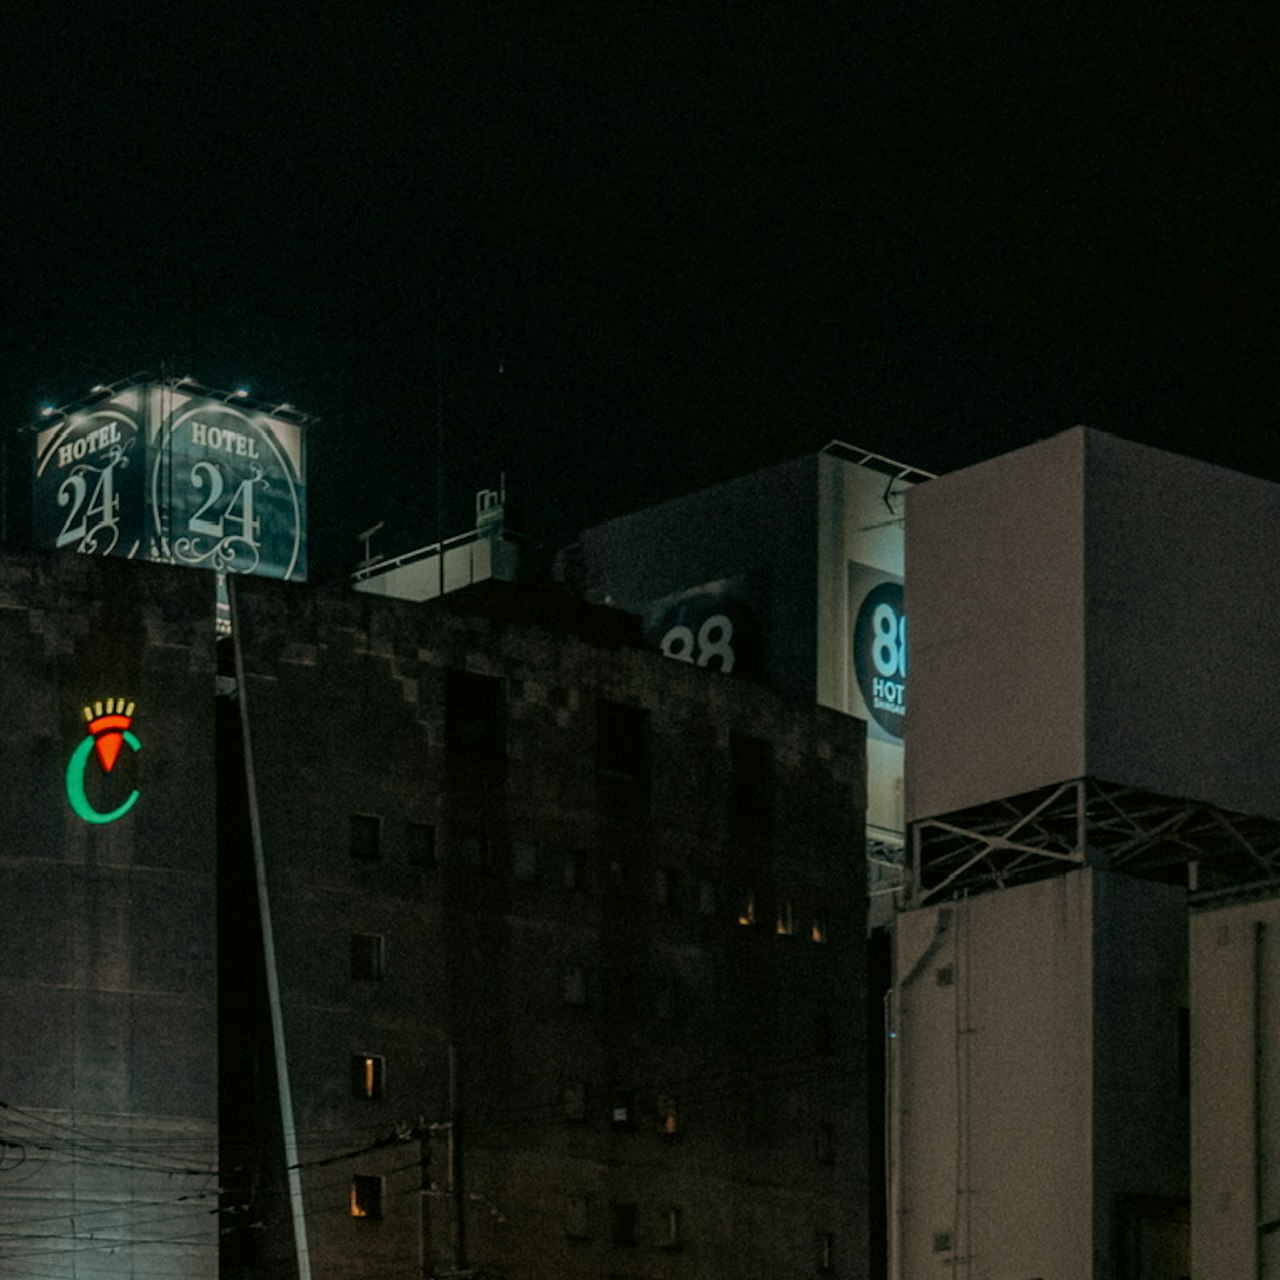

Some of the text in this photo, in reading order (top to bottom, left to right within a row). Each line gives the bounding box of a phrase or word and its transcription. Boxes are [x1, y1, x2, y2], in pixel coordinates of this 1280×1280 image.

[58, 421, 121, 469] HOTEL
[191, 421, 259, 460] HOTEL
[55, 464, 121, 549] 24
[188, 460, 262, 549] 24
[872, 603, 908, 679] 8
